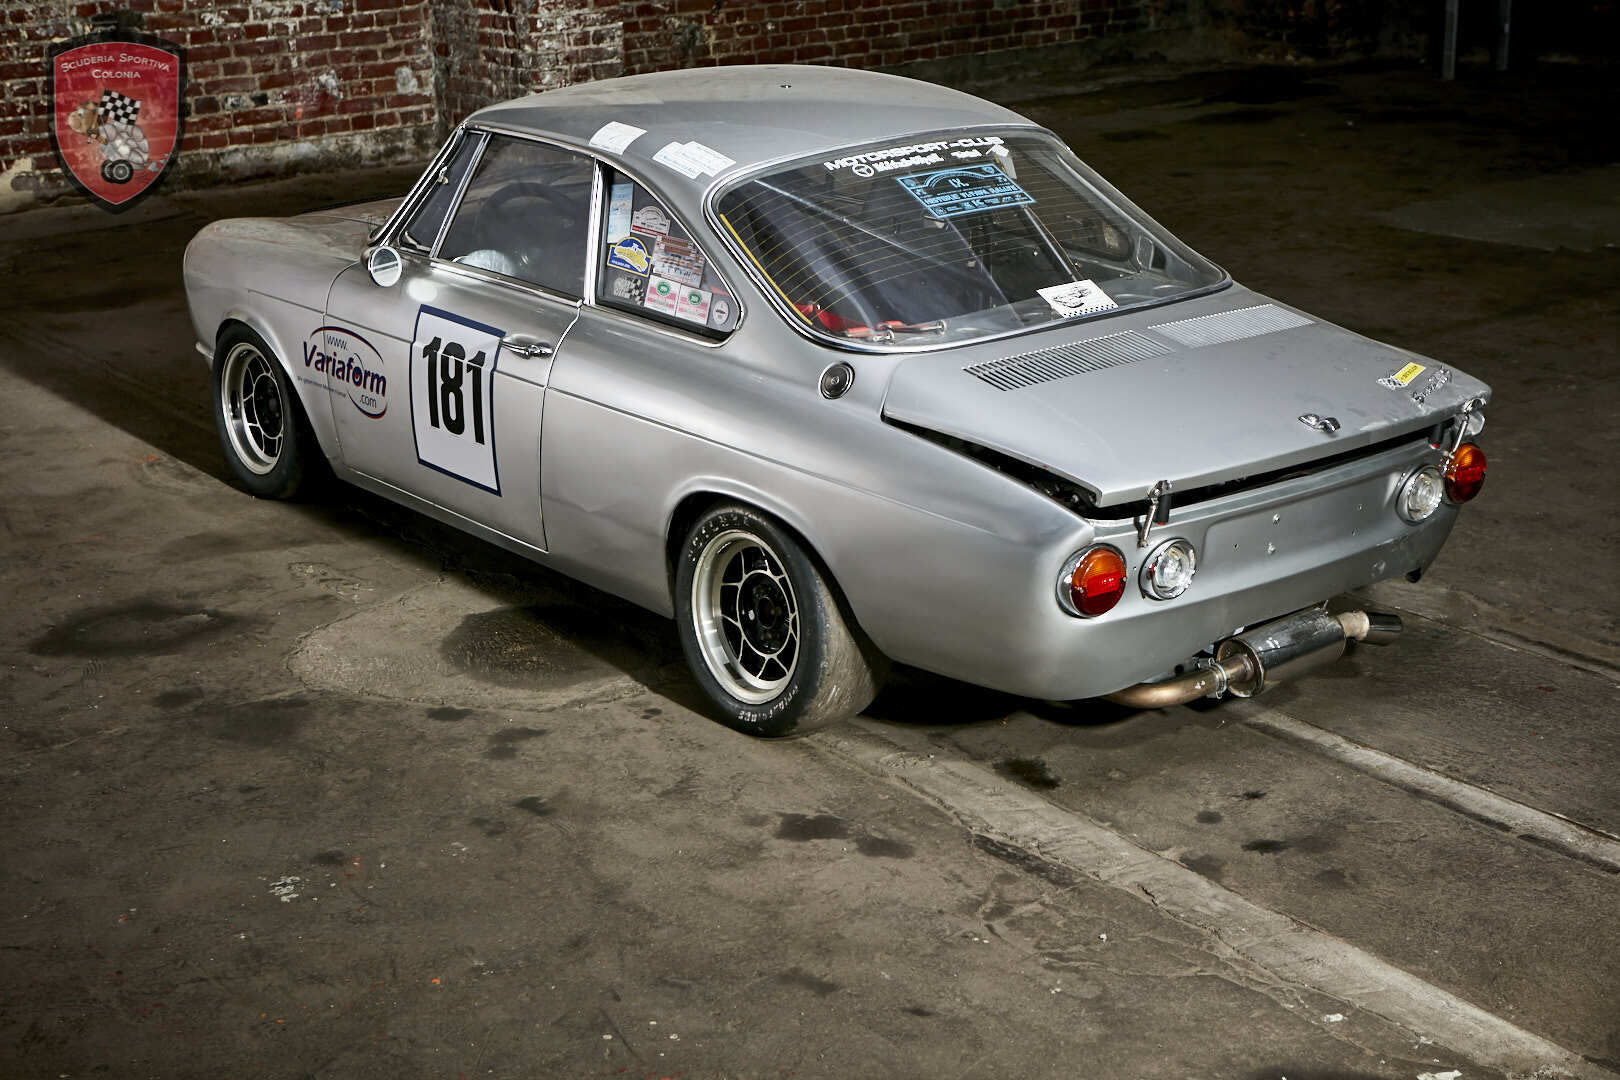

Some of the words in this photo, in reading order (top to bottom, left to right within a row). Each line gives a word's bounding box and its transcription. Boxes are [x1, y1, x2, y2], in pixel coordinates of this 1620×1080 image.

[327, 335, 348, 351] www.
[303, 341, 387, 398] Variaform
[360, 394, 377, 409] .com
[422, 336, 487, 446] 181
